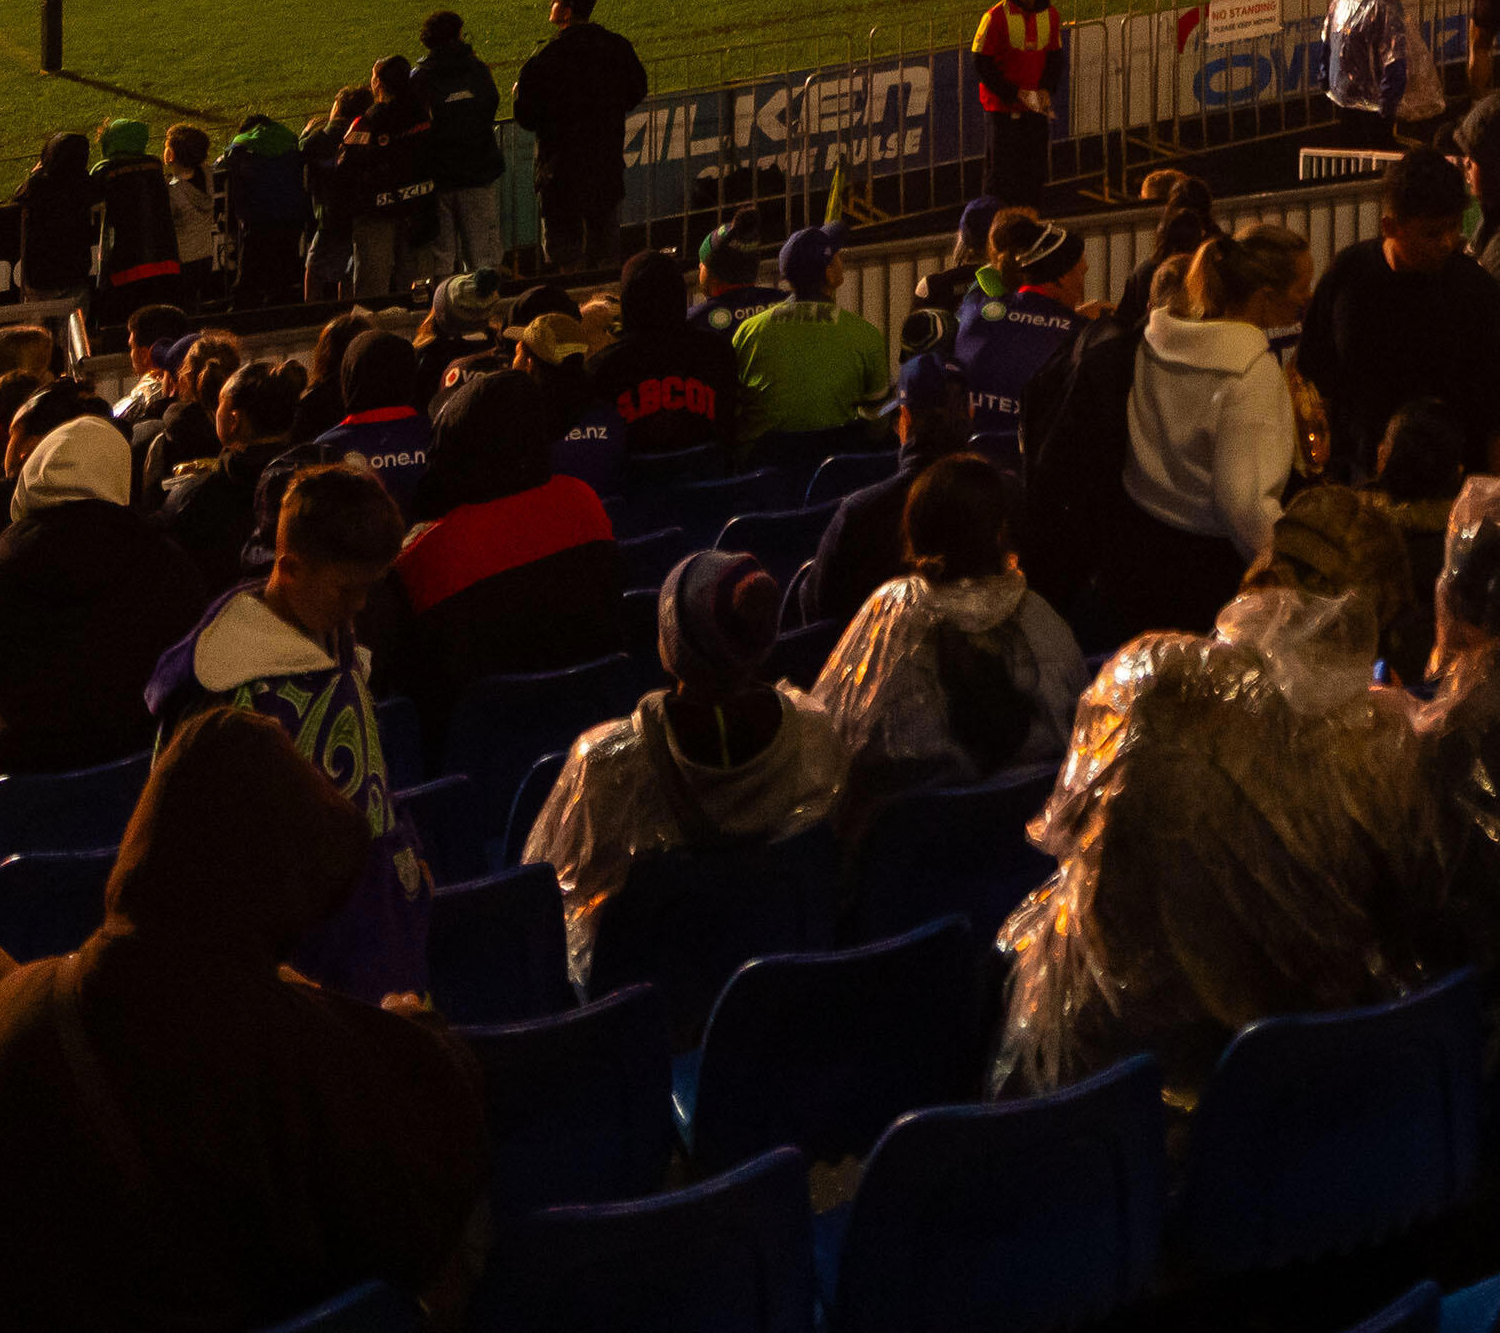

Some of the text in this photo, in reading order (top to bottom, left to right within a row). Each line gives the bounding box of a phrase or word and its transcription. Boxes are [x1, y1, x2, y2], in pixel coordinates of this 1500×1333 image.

[1211, 1, 1277, 22] NO STANDING
[824, 126, 924, 171] PULSE
[1008, 310, 1072, 332] one.nz
[370, 449, 428, 471] one.n
